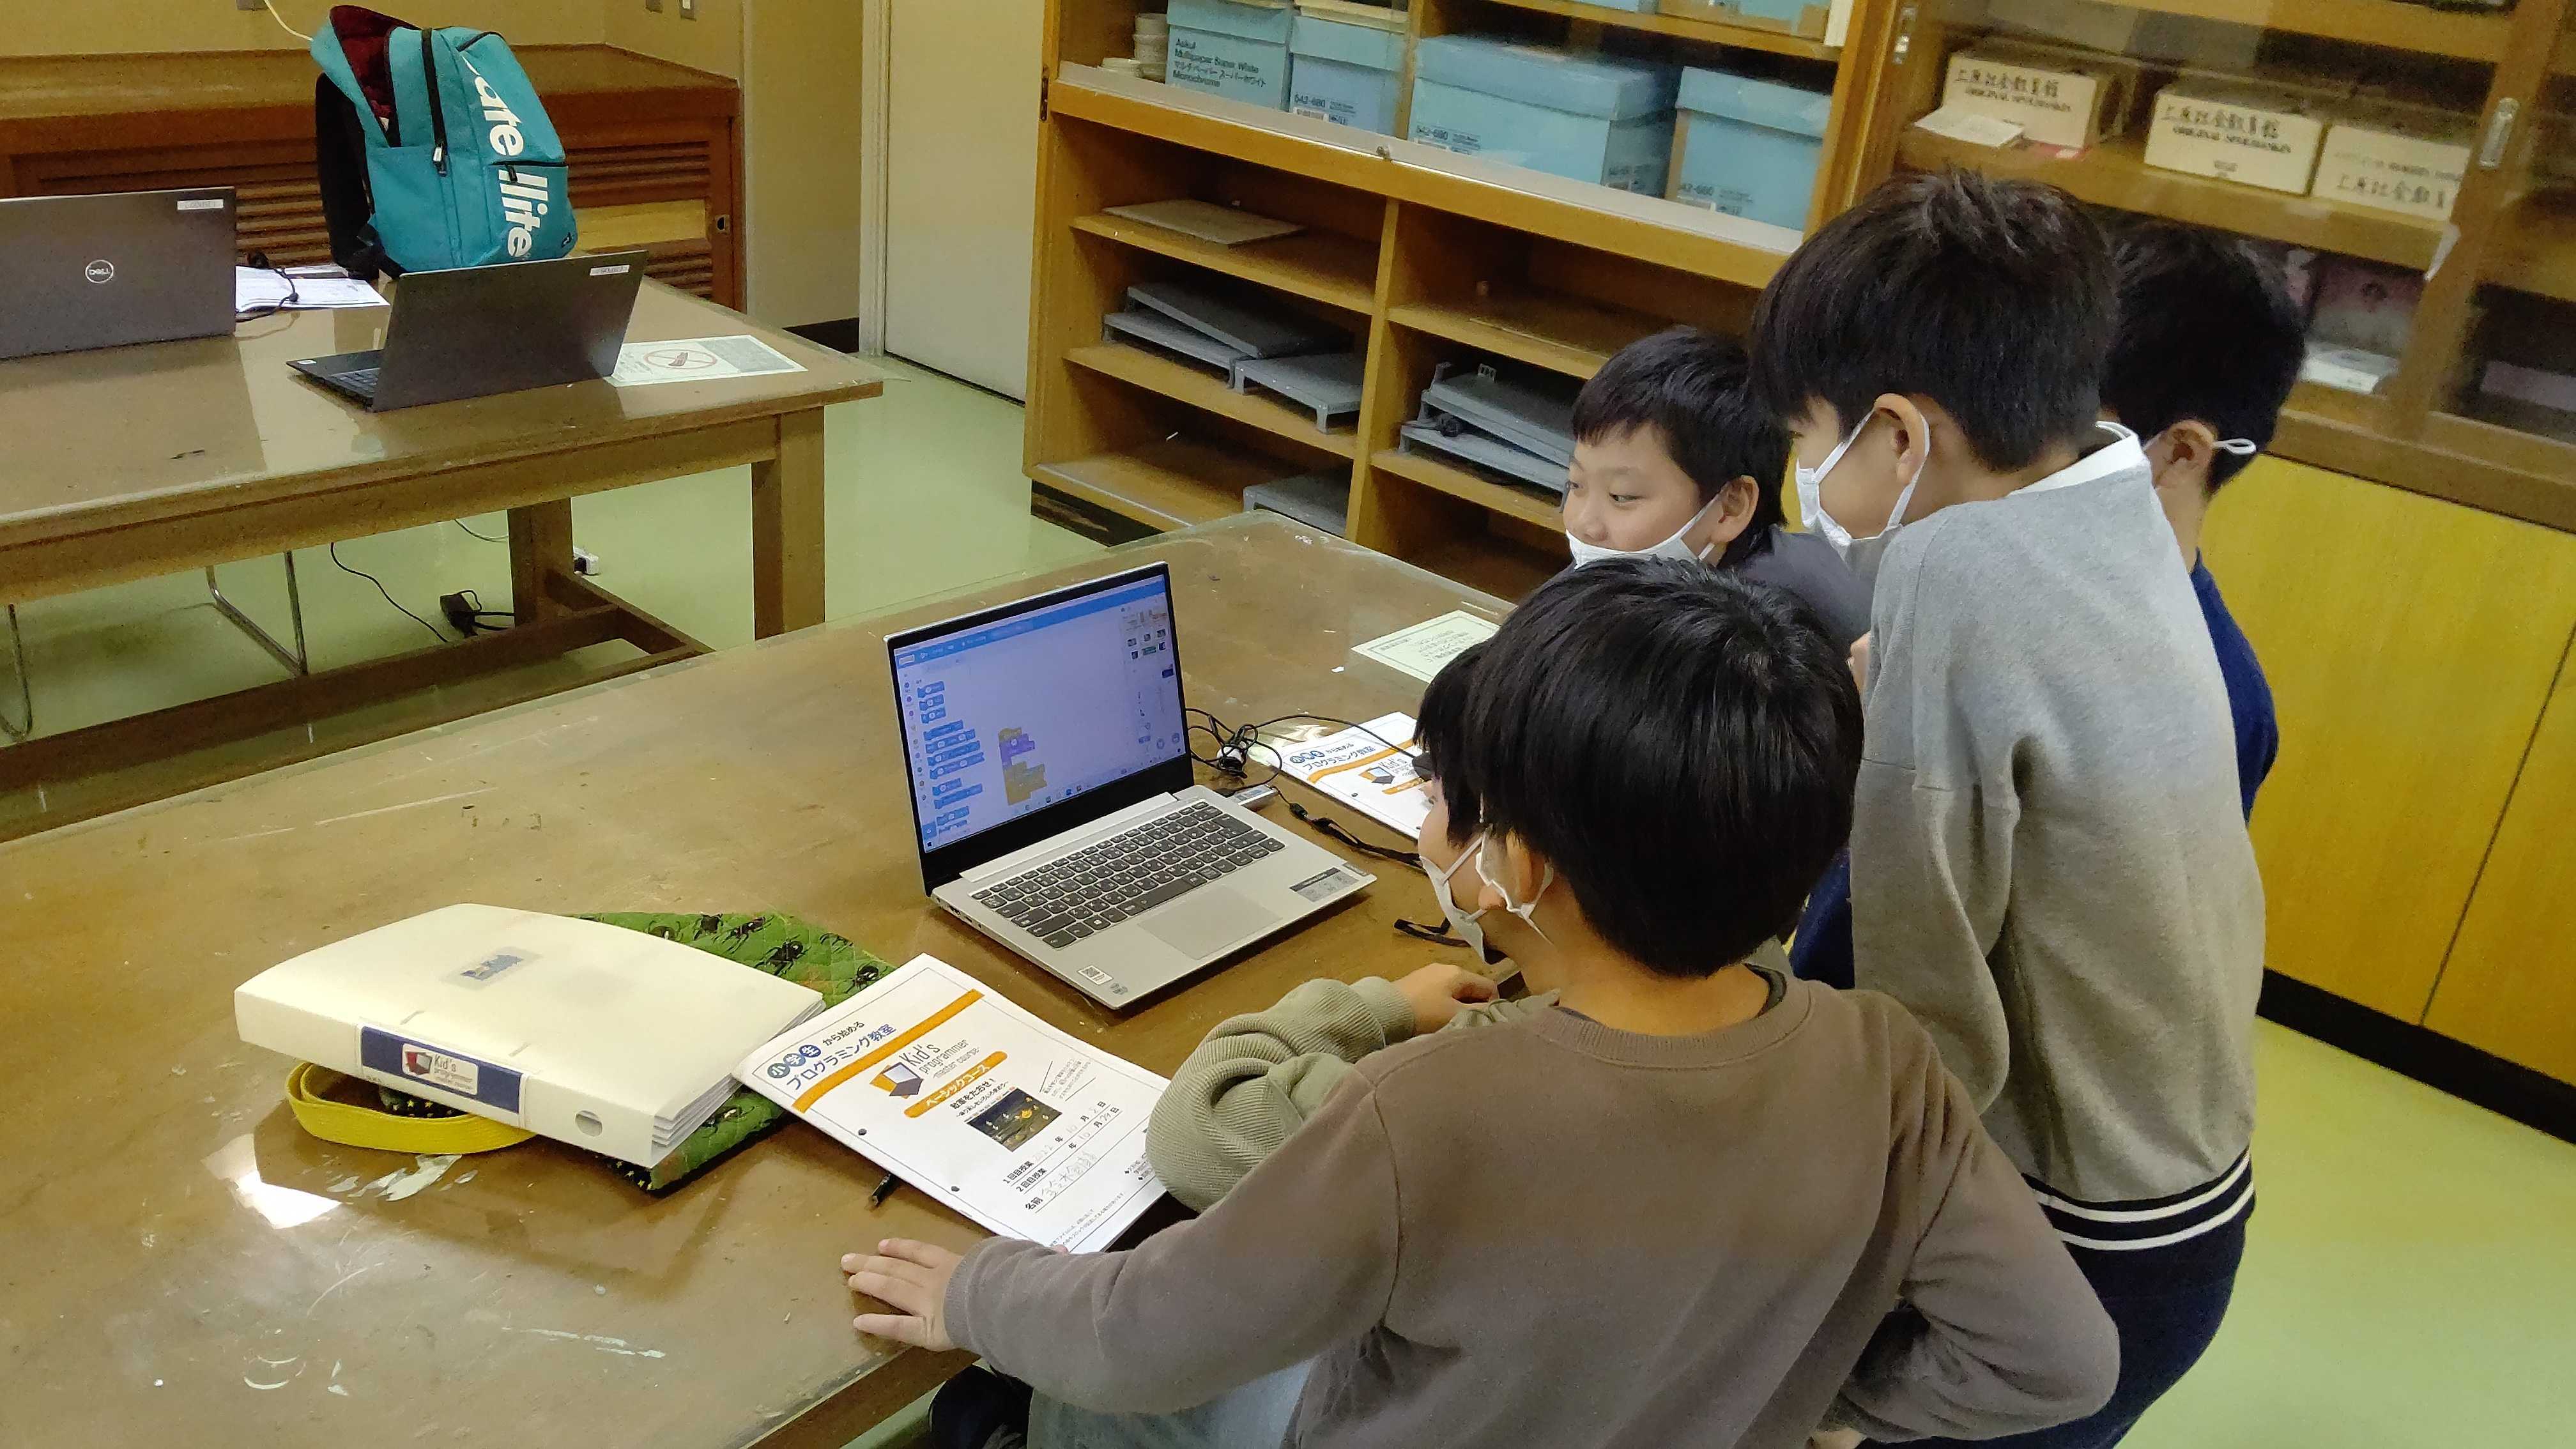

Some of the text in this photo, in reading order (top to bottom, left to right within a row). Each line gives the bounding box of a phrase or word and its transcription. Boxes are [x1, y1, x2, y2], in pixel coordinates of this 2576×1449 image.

[434, 1055, 457, 1073] Kid's
[767, 1021, 865, 1078] 小学生 から始める
[786, 1023, 896, 1090] プログラミング教室
[899, 1044, 941, 1067] Kid's
[919, 1039, 970, 1075] programmer
[1025, 1196, 1043, 1211] 名前
